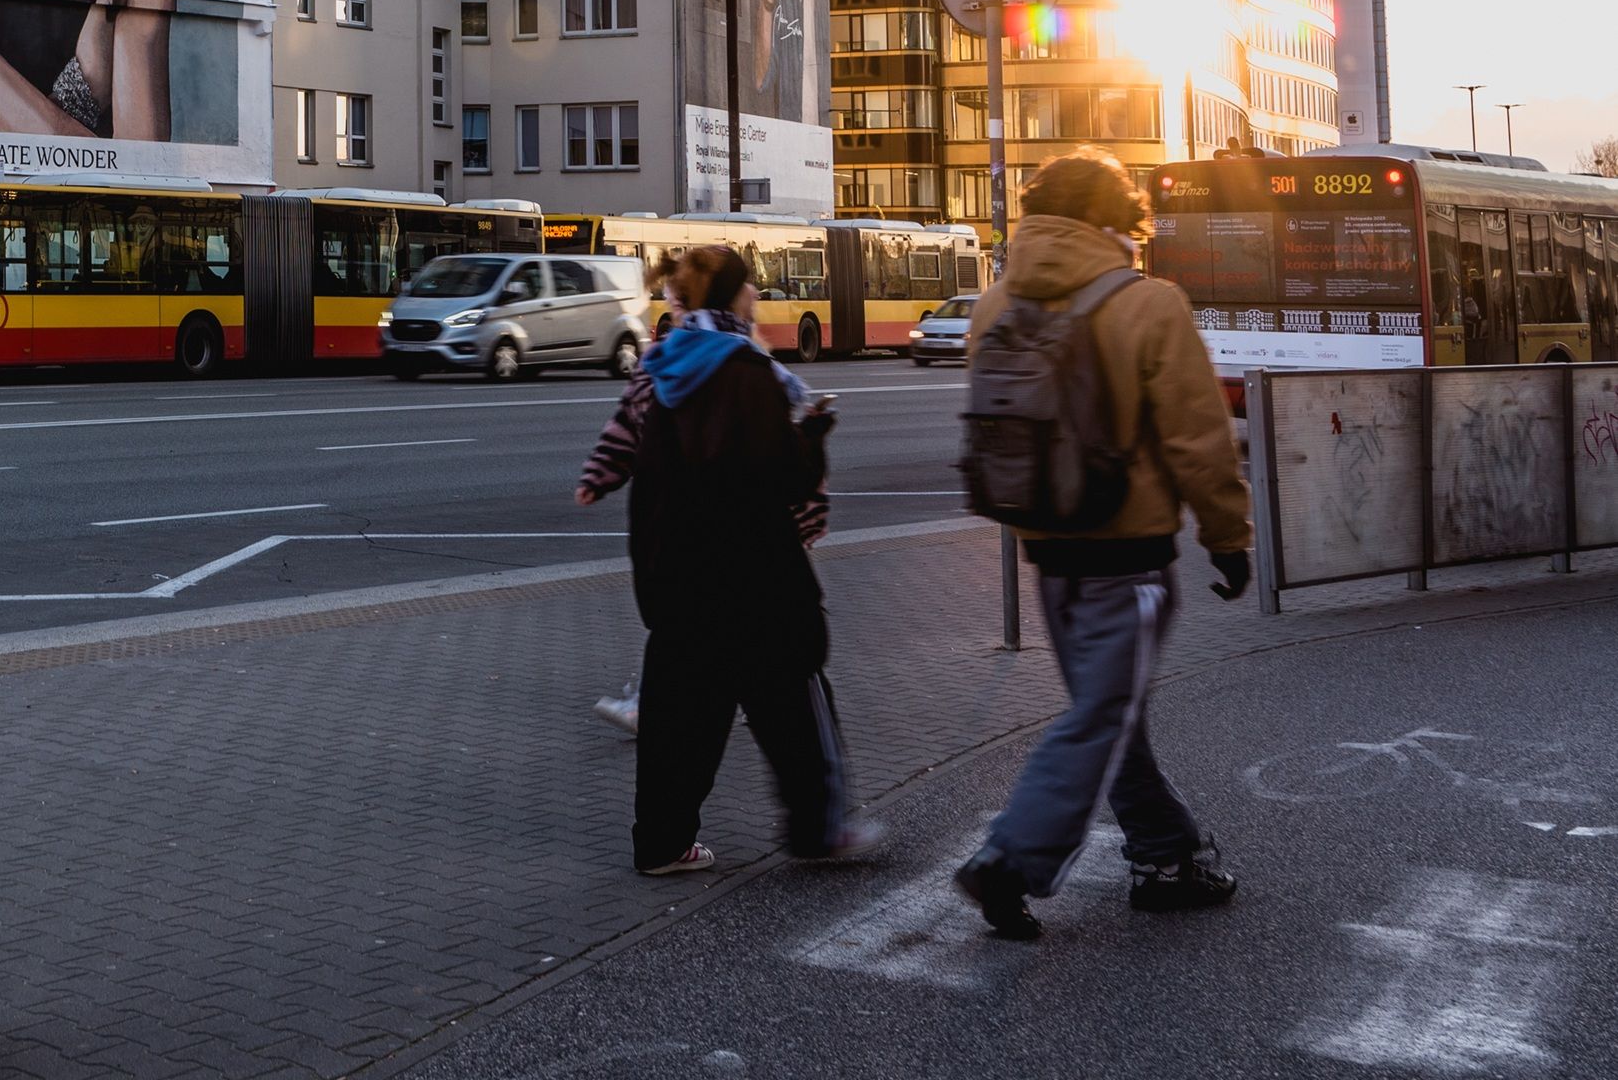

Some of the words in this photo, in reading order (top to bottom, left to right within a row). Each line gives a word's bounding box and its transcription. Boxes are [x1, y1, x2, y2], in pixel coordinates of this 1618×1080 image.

[695, 117, 714, 136] Miele
[747, 124, 767, 143] Center
[35, 145, 119, 170] WONDER
[1271, 175, 1296, 194] 501
[1313, 173, 1373, 195] 8892
